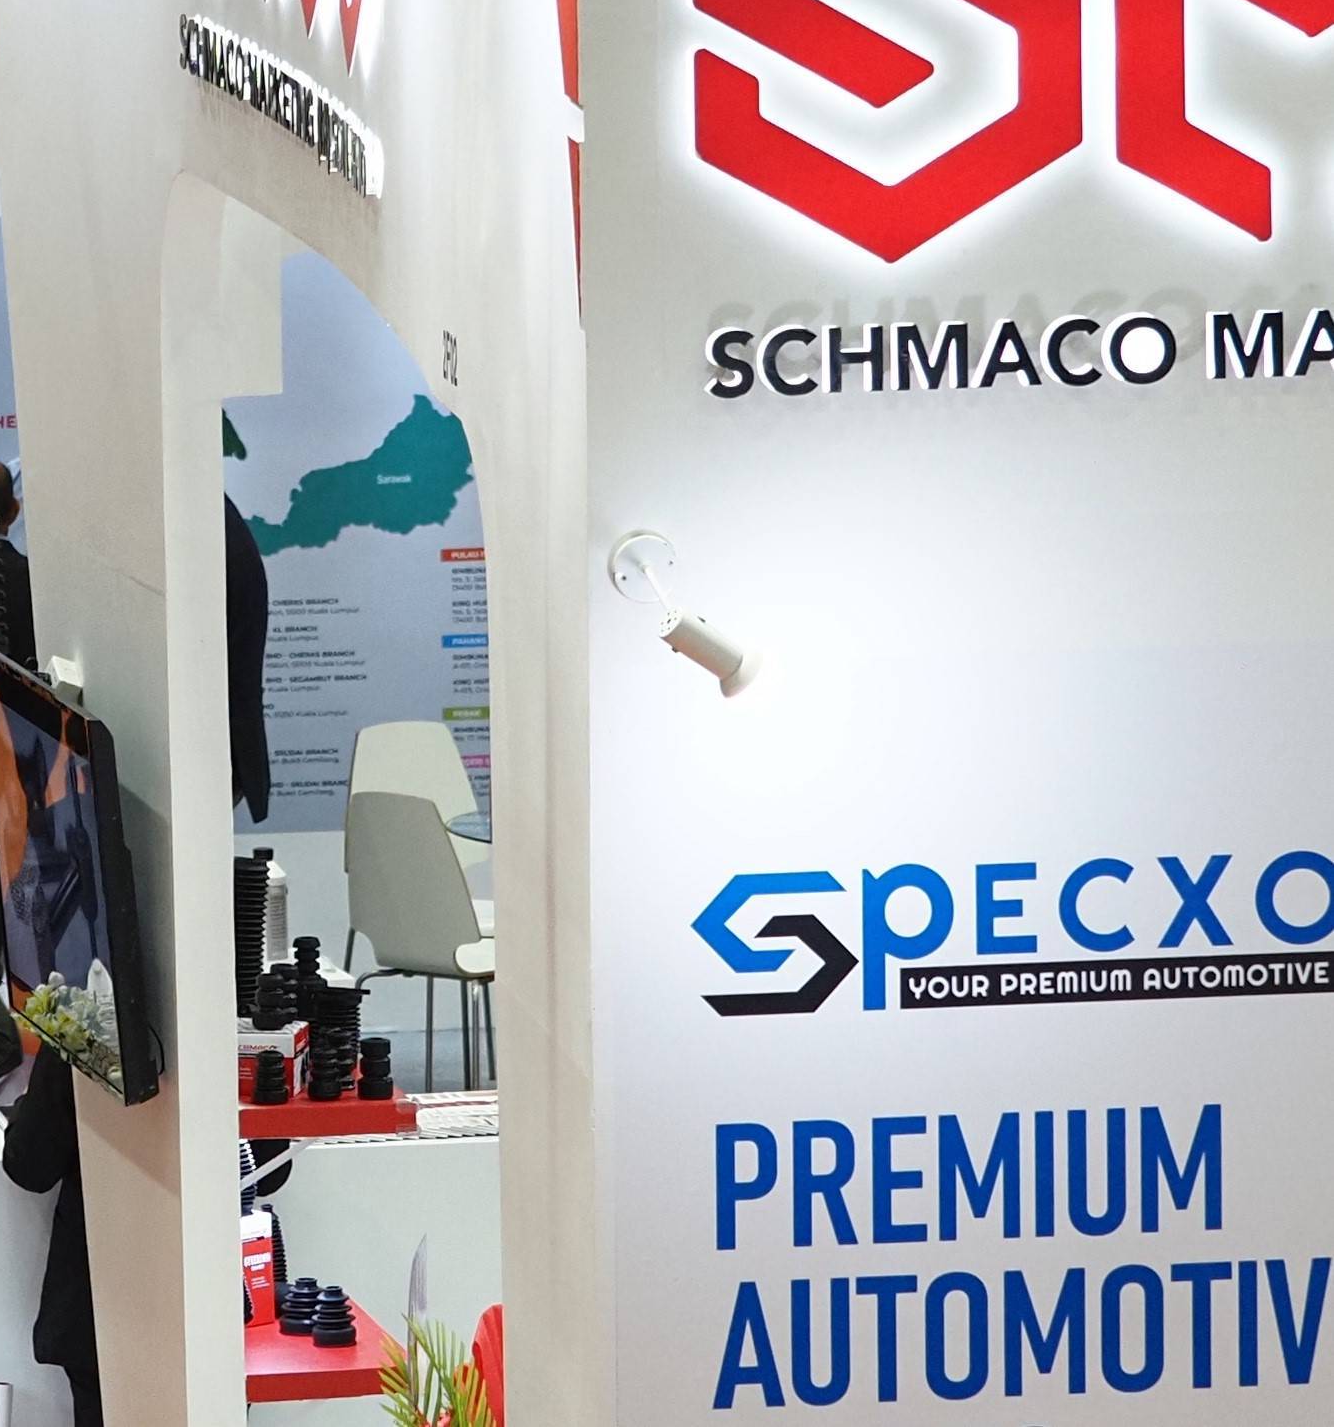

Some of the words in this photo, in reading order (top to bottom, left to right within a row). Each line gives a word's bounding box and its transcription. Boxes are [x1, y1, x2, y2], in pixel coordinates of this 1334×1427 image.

[704, 313, 1177, 400] SCHMACO
[377, 475, 411, 485] Sarawak
[908, 970, 990, 1001] YOUR
[1000, 964, 1131, 997] PREMIUM
[1142, 959, 1330, 991] AUTOMOTIVE
[714, 1104, 1222, 1251] PREMIUM
[712, 1255, 1331, 1411] AUTOMOTIV
